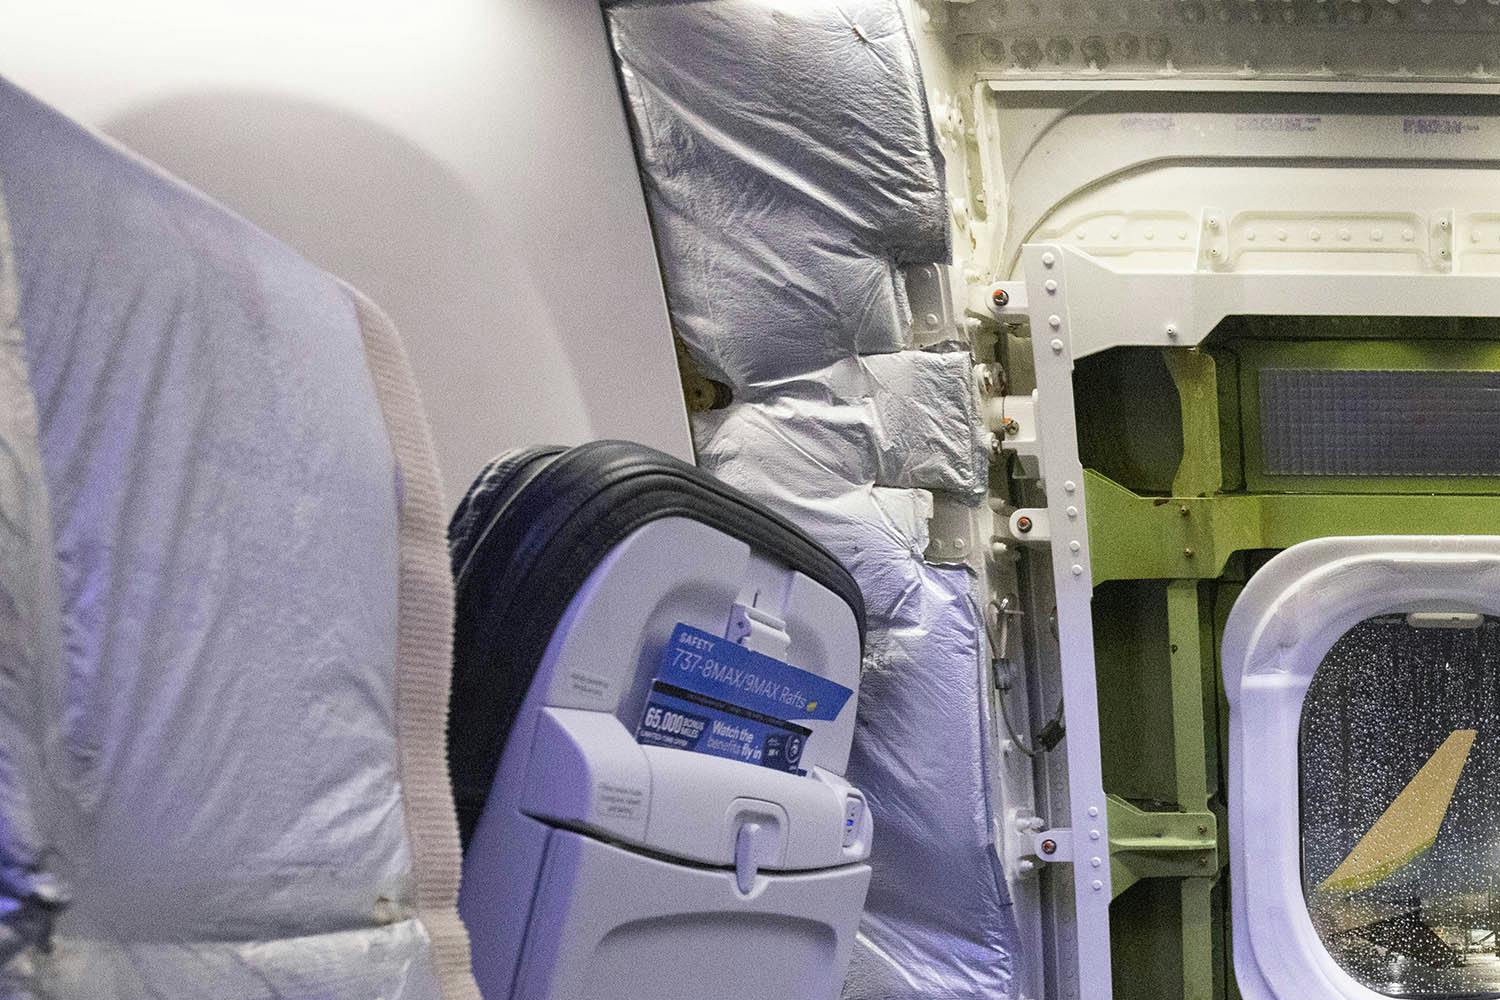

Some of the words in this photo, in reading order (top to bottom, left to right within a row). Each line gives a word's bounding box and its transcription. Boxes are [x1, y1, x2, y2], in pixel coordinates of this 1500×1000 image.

[680, 632, 715, 652] SAFETY
[672, 648, 781, 699] 737-8MAX/9MAX
[781, 686, 807, 709] Rafts
[644, 707, 684, 733] 65,000
[712, 720, 739, 740] Watch
[739, 728, 754, 743] the
[741, 742, 753, 760] fly
[752, 745, 762, 760] in
